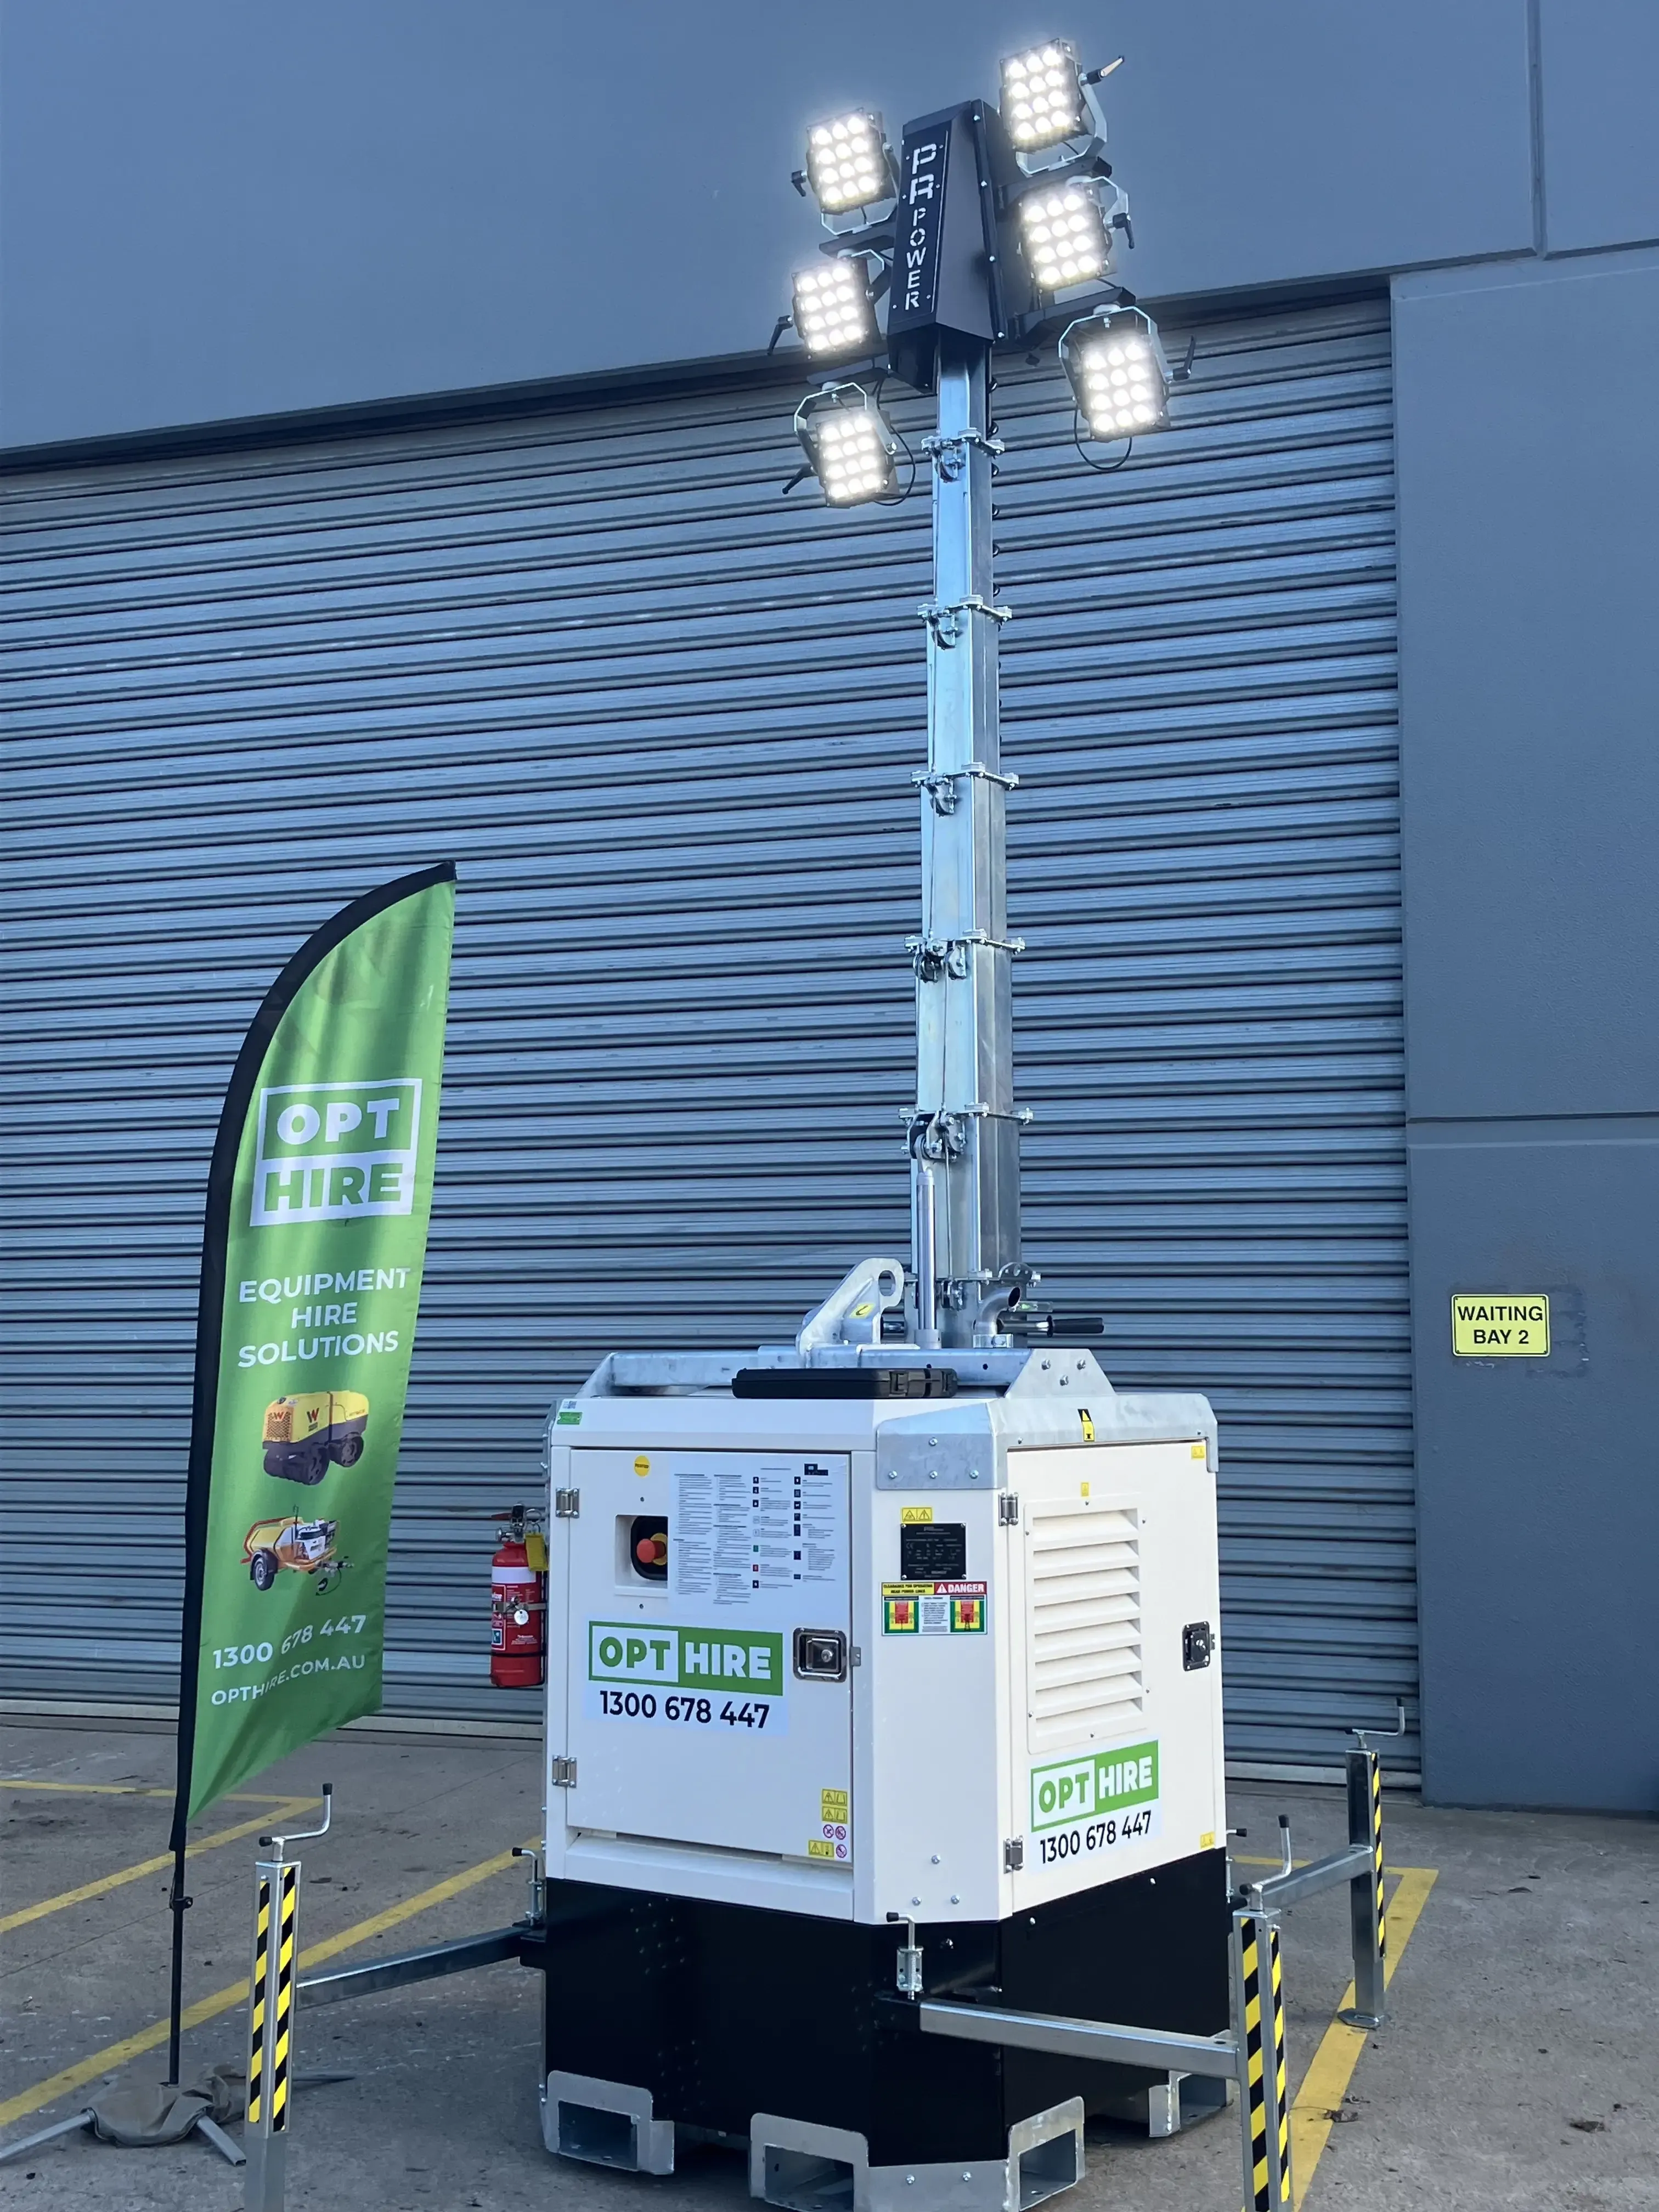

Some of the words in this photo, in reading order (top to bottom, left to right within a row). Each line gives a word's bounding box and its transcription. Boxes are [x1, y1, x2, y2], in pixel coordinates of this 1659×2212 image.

[905, 207, 927, 311] POWER
[277, 1098, 400, 1146] OPT
[264, 1163, 403, 1212] HIRE
[239, 1267, 411, 1304] EQUIPMENT
[291, 1302, 358, 1329] HIRE
[1457, 1306, 1543, 1321] WAITING
[238, 1330, 399, 1368] SOLUTIONS
[1473, 1329, 1512, 1344] BAY
[1518, 1329, 1530, 1344] 2
[947, 1583, 985, 1593] DANGER
[213, 1642, 273, 1669] 1300
[281, 1625, 313, 1655] 678
[320, 1615, 366, 1636] 447
[600, 1637, 670, 1671] OPT
[685, 1641, 771, 1680] HIRE
[211, 1655, 365, 1705] OPTHIRE.COM.AU
[600, 1690, 657, 1718] 1300
[665, 1696, 712, 1724] 678
[720, 1701, 770, 1729] 447
[1039, 1771, 1090, 1813] OPT
[1099, 1756, 1153, 1799] HIRE
[1040, 1830, 1080, 1864] 1300
[1086, 1820, 1116, 1850] 678
[1122, 1810, 1152, 1839] 447
